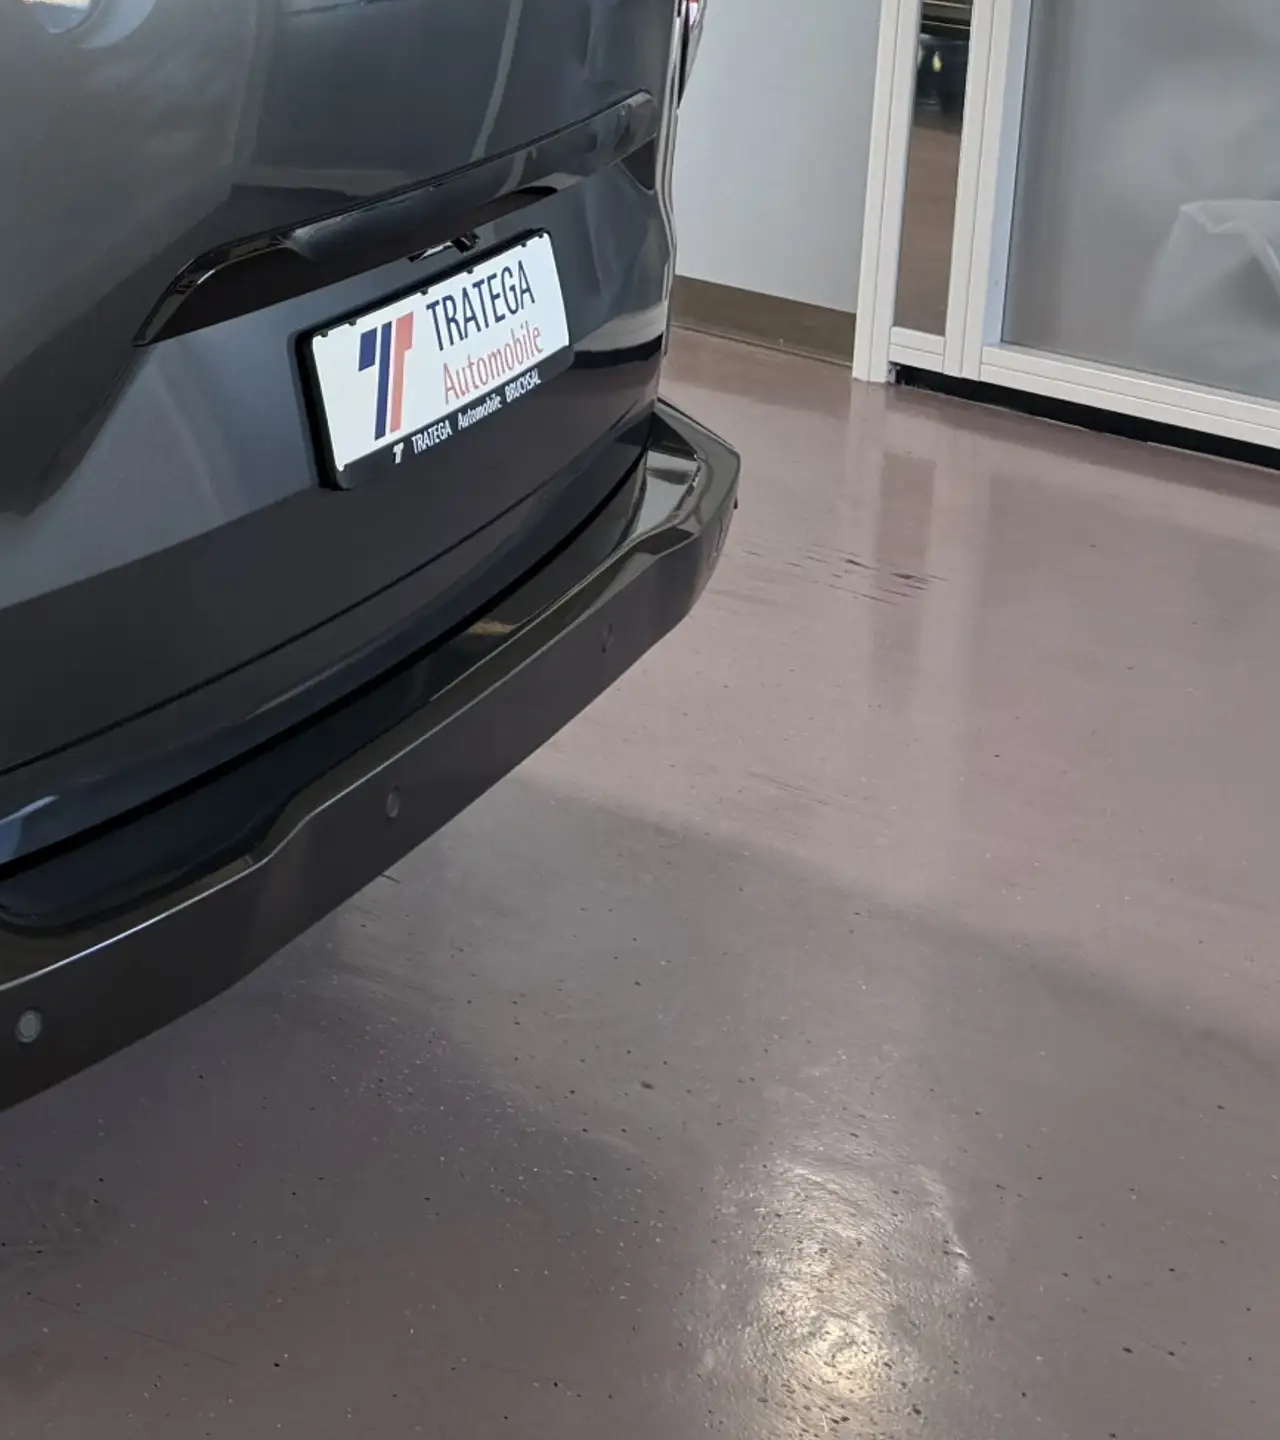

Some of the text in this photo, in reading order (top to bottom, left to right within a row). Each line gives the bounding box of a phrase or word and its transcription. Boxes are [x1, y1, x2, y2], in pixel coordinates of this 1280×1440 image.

[426, 260, 535, 352] TRATEGA
[442, 320, 544, 406] Automobile
[411, 367, 542, 455] TRATEGA Automobile BRUCHSAL
